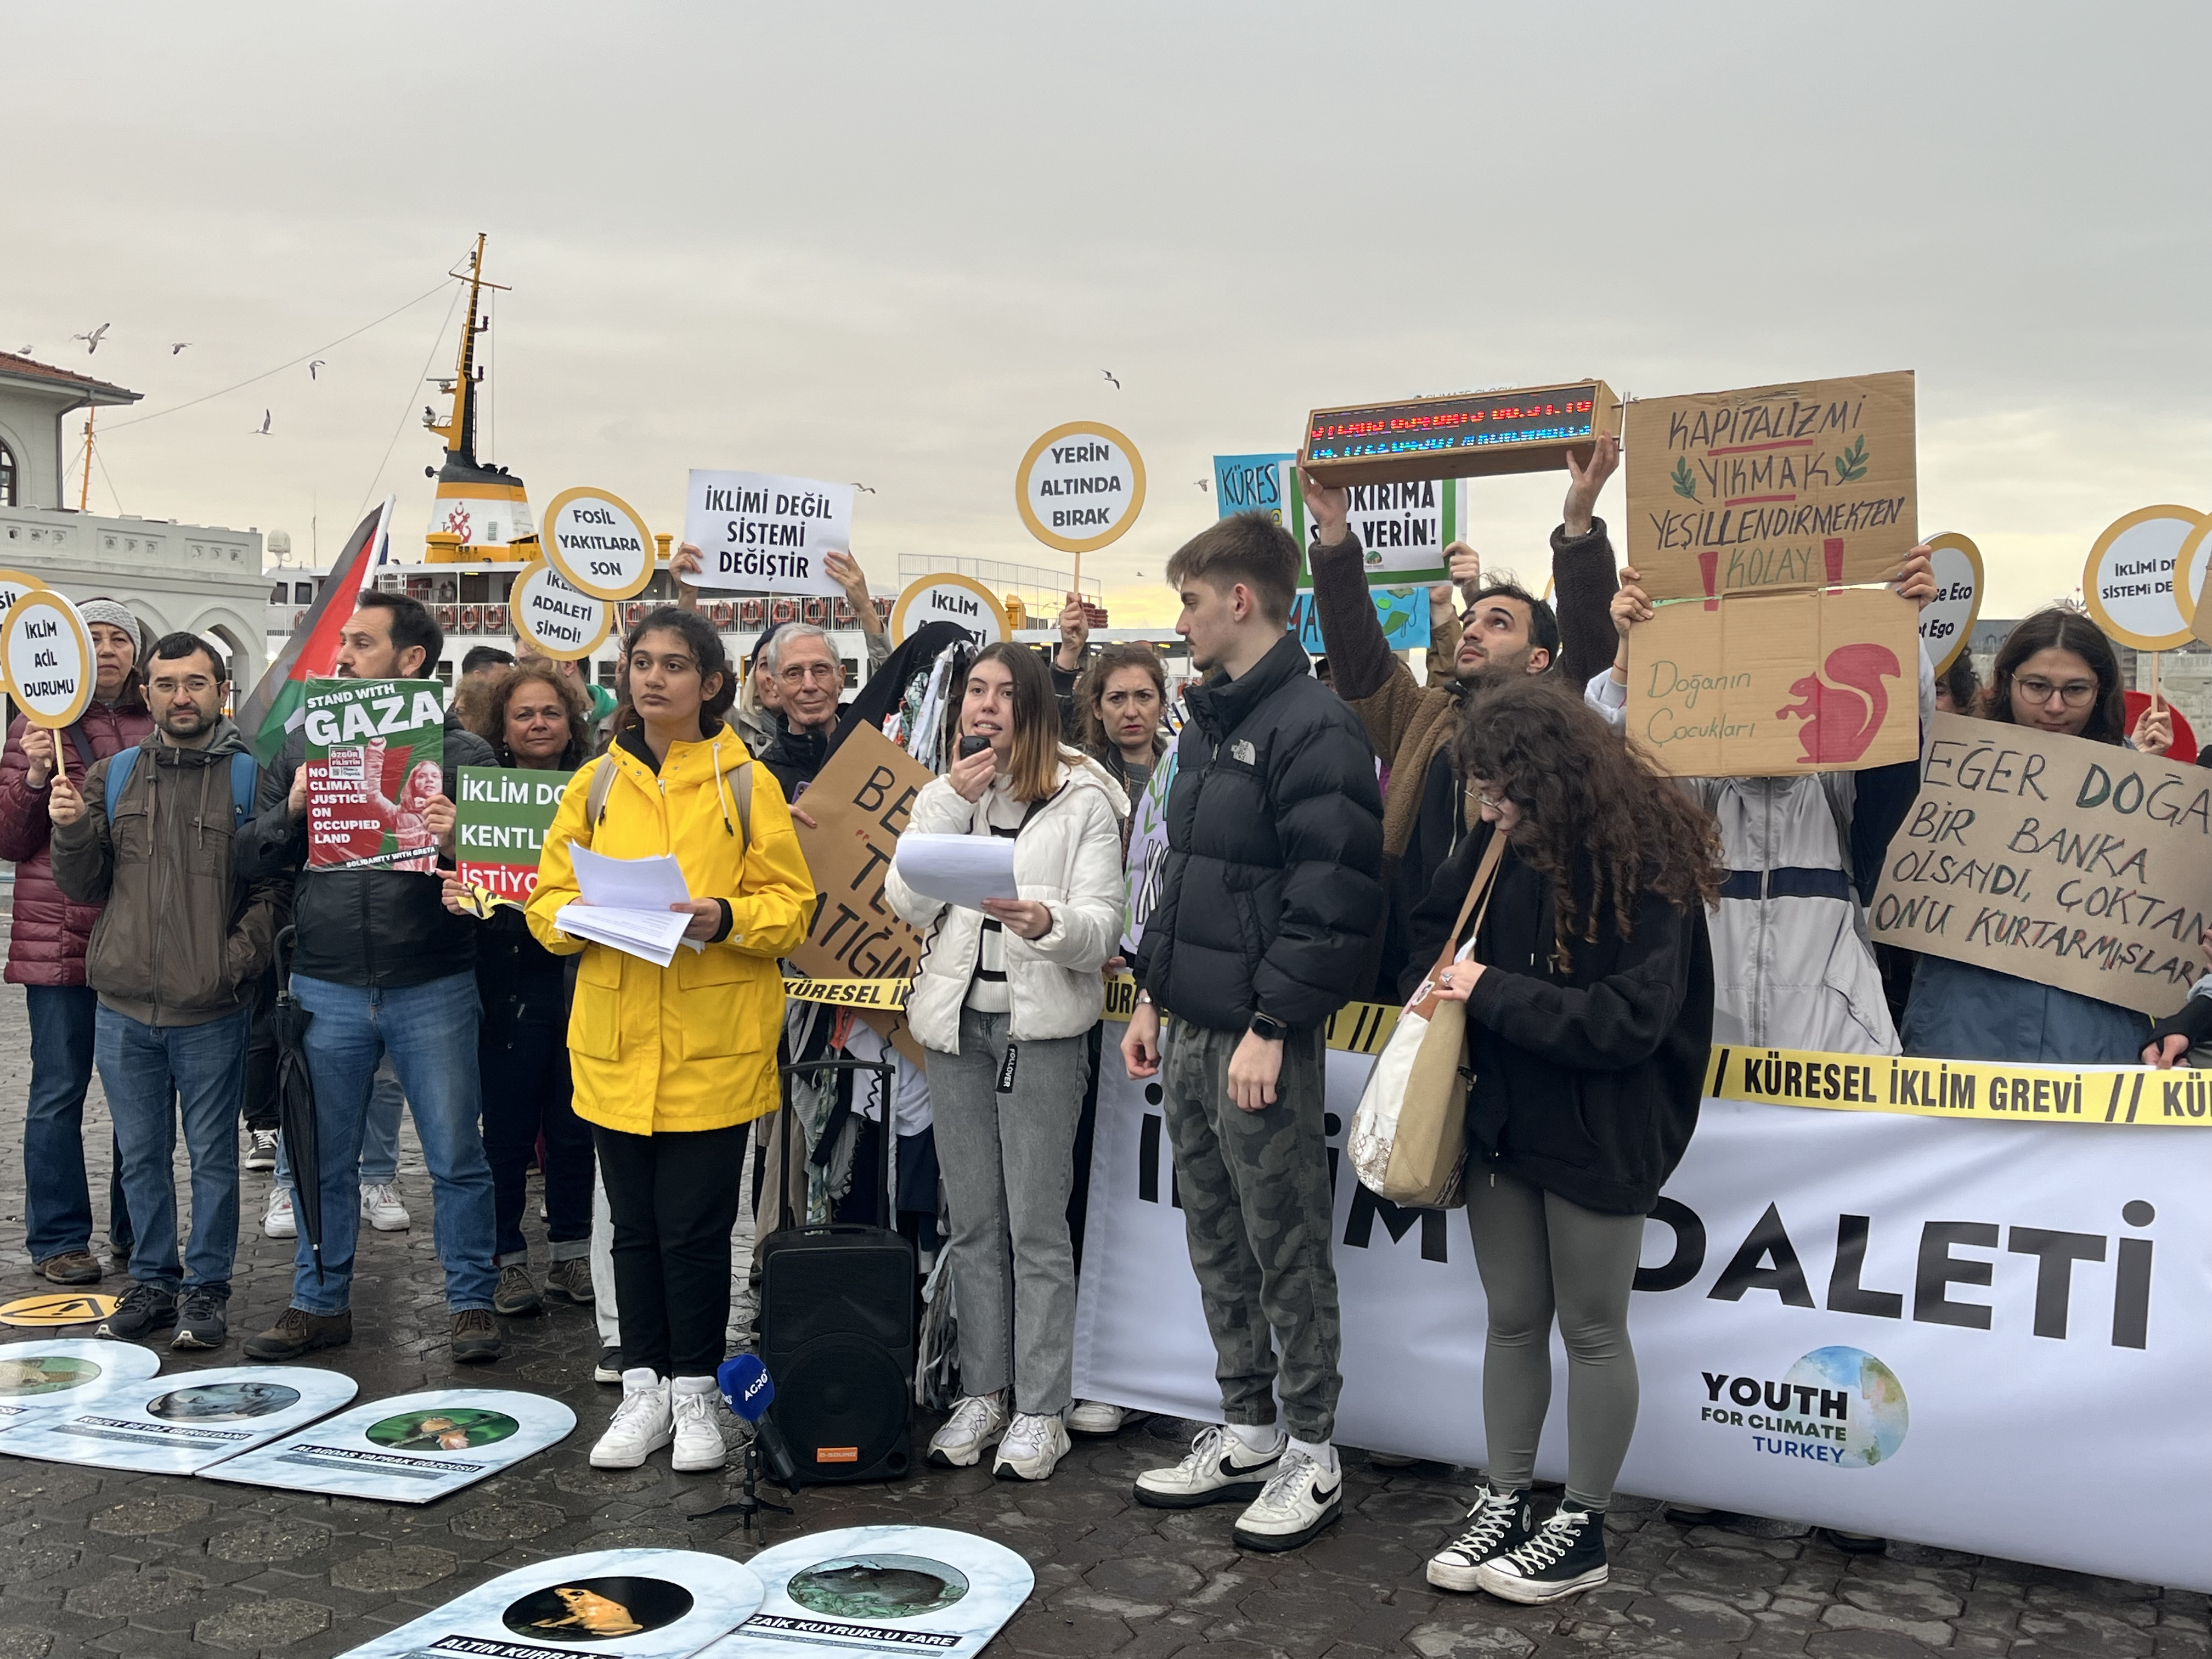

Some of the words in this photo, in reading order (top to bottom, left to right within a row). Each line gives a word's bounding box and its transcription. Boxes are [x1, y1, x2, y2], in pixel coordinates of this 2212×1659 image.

[1051, 442, 1109, 464] YERİN
[1040, 476, 1121, 496] ALTINDA
[1221, 464, 1281, 506] KÜRES
[1699, 452, 1829, 498] YIKMAK
[706, 485, 768, 514] İKLİMİ
[776, 492, 832, 520] DEĞİL
[573, 508, 616, 524] FOSİL
[1053, 507, 1110, 527] BIRAK
[1649, 496, 1905, 550] YEŞİLLENDİRMEKTEN
[558, 534, 641, 551] YAKITLARA
[727, 517, 805, 548] SİSTEMİ
[1363, 512, 1436, 548] VERİN!
[590, 562, 622, 575] SON
[719, 548, 809, 582] DEĞİŞTİR
[1726, 546, 1812, 589] KOLAY
[2115, 559, 2157, 577] İKLİMİ
[932, 590, 978, 617] İKLİM
[1949, 582, 1972, 600] Eco
[533, 595, 592, 621] ADALETİ
[25, 619, 57, 639] İKLİM
[535, 619, 581, 644] ŞİMDİ!
[1929, 619, 1954, 638] Ego
[35, 648, 58, 668] ACİL
[24, 679, 74, 697] DURUMU
[307, 691, 353, 708] STAND
[355, 683, 396, 699] WITH
[1647, 661, 1751, 709] Doğanın
[305, 691, 444, 746] GAZA
[1647, 708, 1756, 748] Çocukları
[309, 768, 328, 777] NO
[309, 781, 369, 791] CLIMATE
[462, 774, 529, 804] İKLİM
[1923, 740, 2048, 801] EĞER
[2075, 763, 2211, 834] DOĞA
[311, 794, 368, 804] JUSTICE
[312, 808, 331, 817] ON
[313, 820, 381, 831] OCCUPIED
[314, 833, 351, 844] LAND
[1909, 801, 1976, 847] BİR
[2007, 817, 2148, 884] BANKA
[346, 854, 391, 868] SOLIDARITY
[391, 851, 413, 860] WITH
[412, 846, 436, 856] GRETA
[1892, 850, 2033, 903] OLSAYDI,
[1875, 893, 1955, 936] ONU
[1744, 1051, 1877, 1103] KÜRESEL
[1889, 1059, 1975, 1109] İKLİM
[1989, 1074, 2082, 1114] GREVİ
[2163, 1071, 2212, 1117] KÜ
[1701, 1372, 1848, 1420] YOUTH
[1702, 1407, 1743, 1426] FOR
[1748, 1414, 1847, 1441] CLIMATE
[359, 1453, 414, 1464] YAPRAK
[1752, 1436, 1845, 1463] TURKEY
[437, 1638, 504, 1654] ALTIN
[795, 1622, 901, 1640] KUYRUKLU
[901, 1633, 955, 1646] FARE
